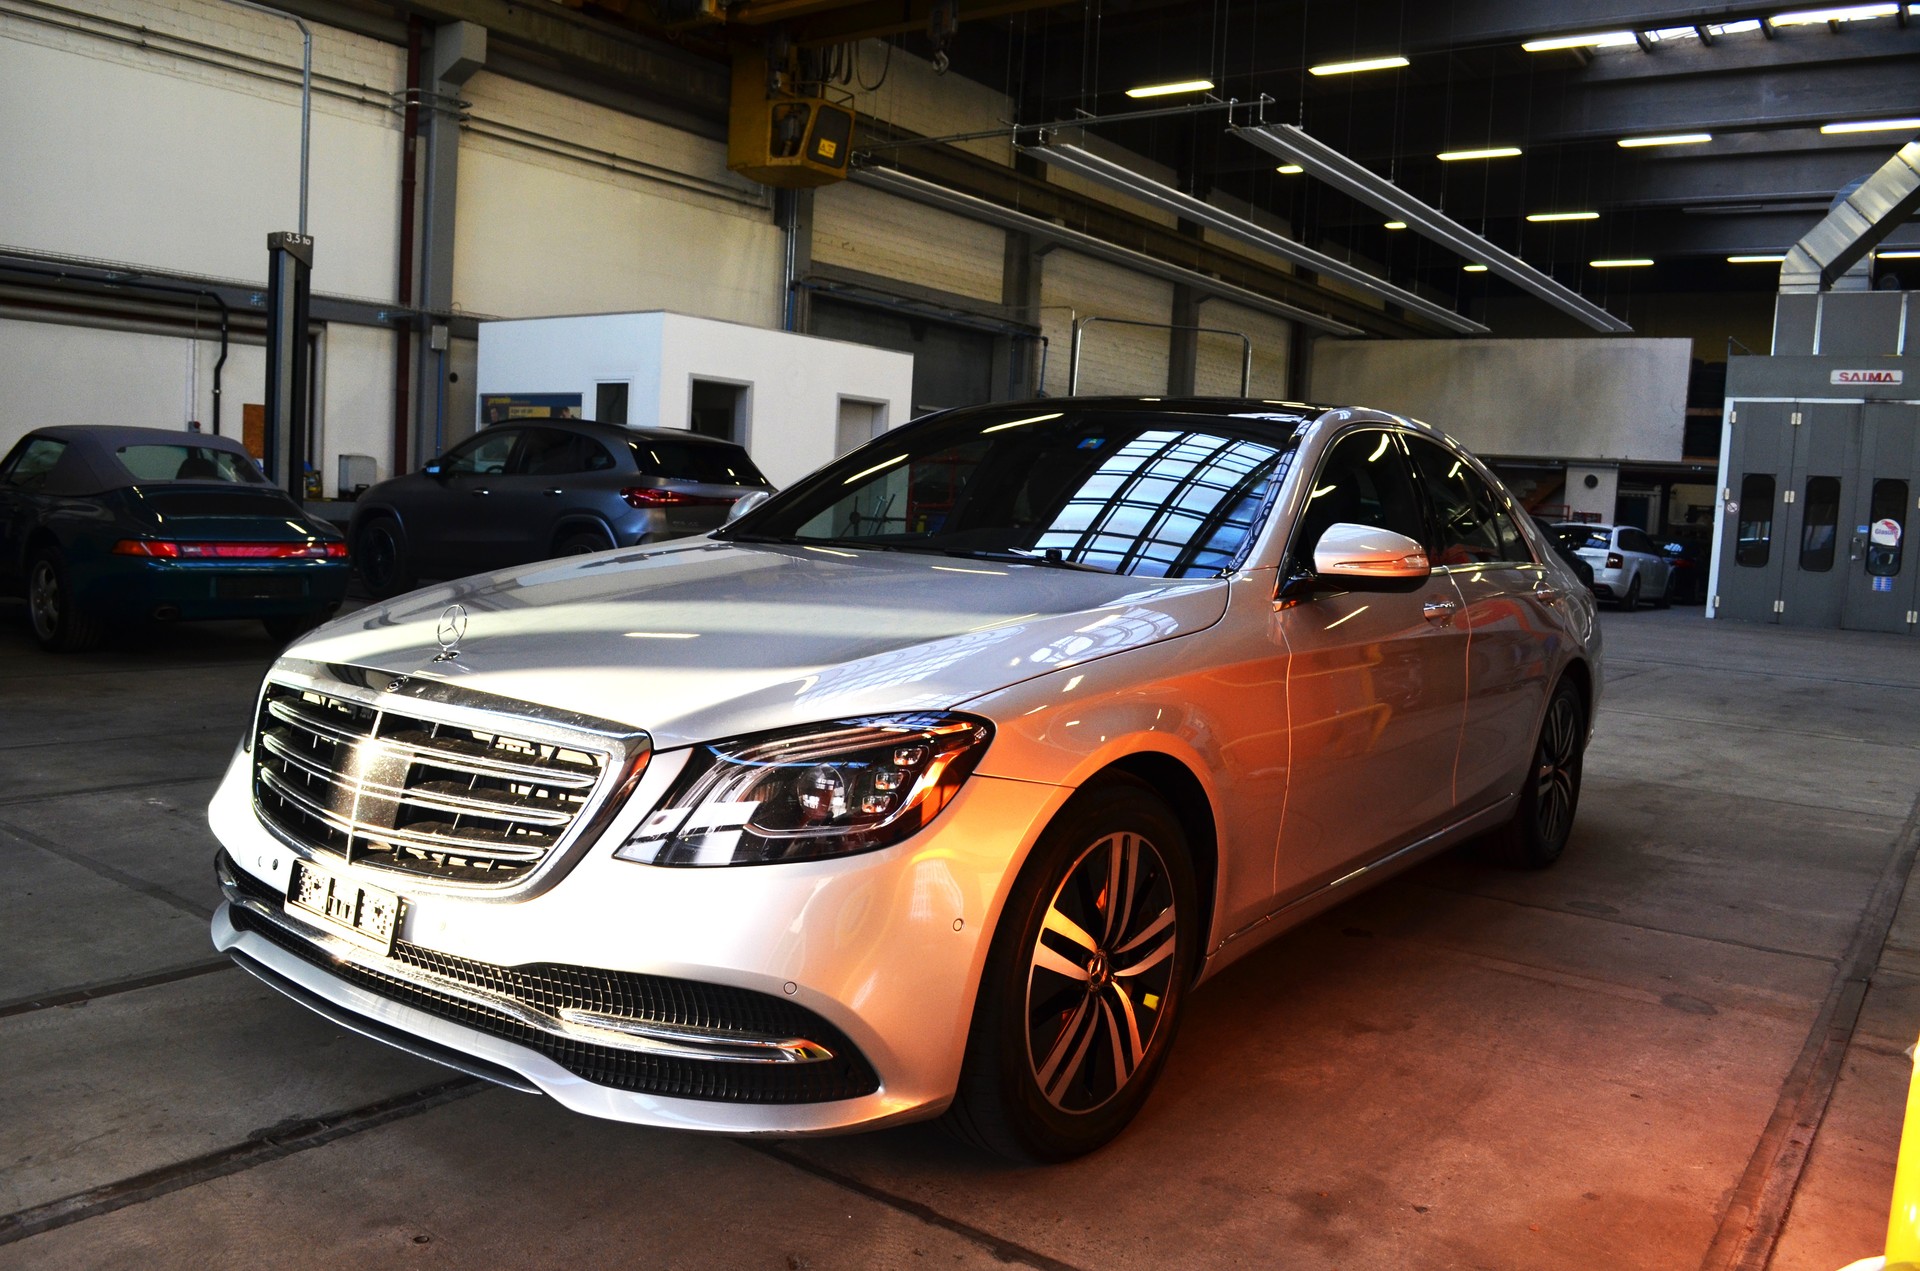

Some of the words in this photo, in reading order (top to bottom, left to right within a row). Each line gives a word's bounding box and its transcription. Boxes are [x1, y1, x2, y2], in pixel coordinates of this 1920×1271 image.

[286, 232, 300, 244] 3,5
[303, 237, 311, 245] to
[1839, 371, 1893, 382] SAIMA
